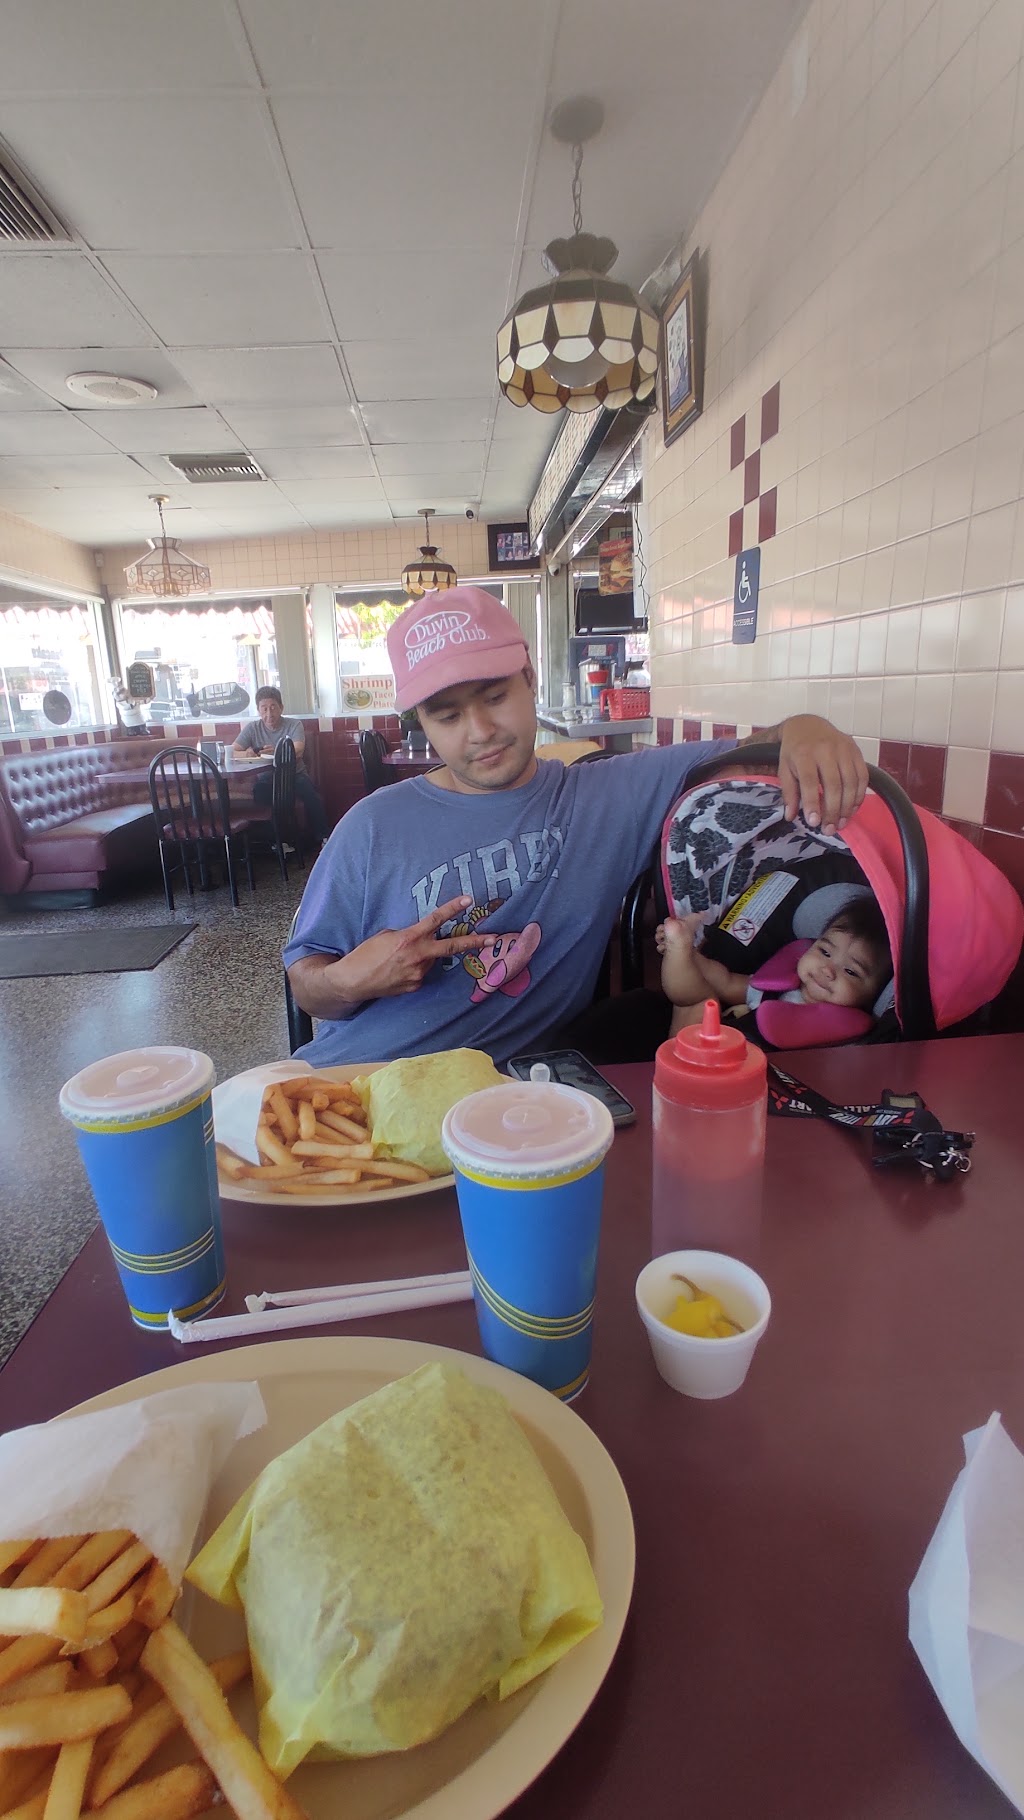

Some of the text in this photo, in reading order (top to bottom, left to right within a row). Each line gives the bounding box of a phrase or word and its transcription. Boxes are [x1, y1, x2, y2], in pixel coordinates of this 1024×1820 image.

[413, 614, 460, 642] Duvin
[406, 632, 446, 671] Beach
[342, 678, 393, 690] Shrimp
[373, 691, 393, 699] Taco
[411, 825, 563, 936] KIRB
